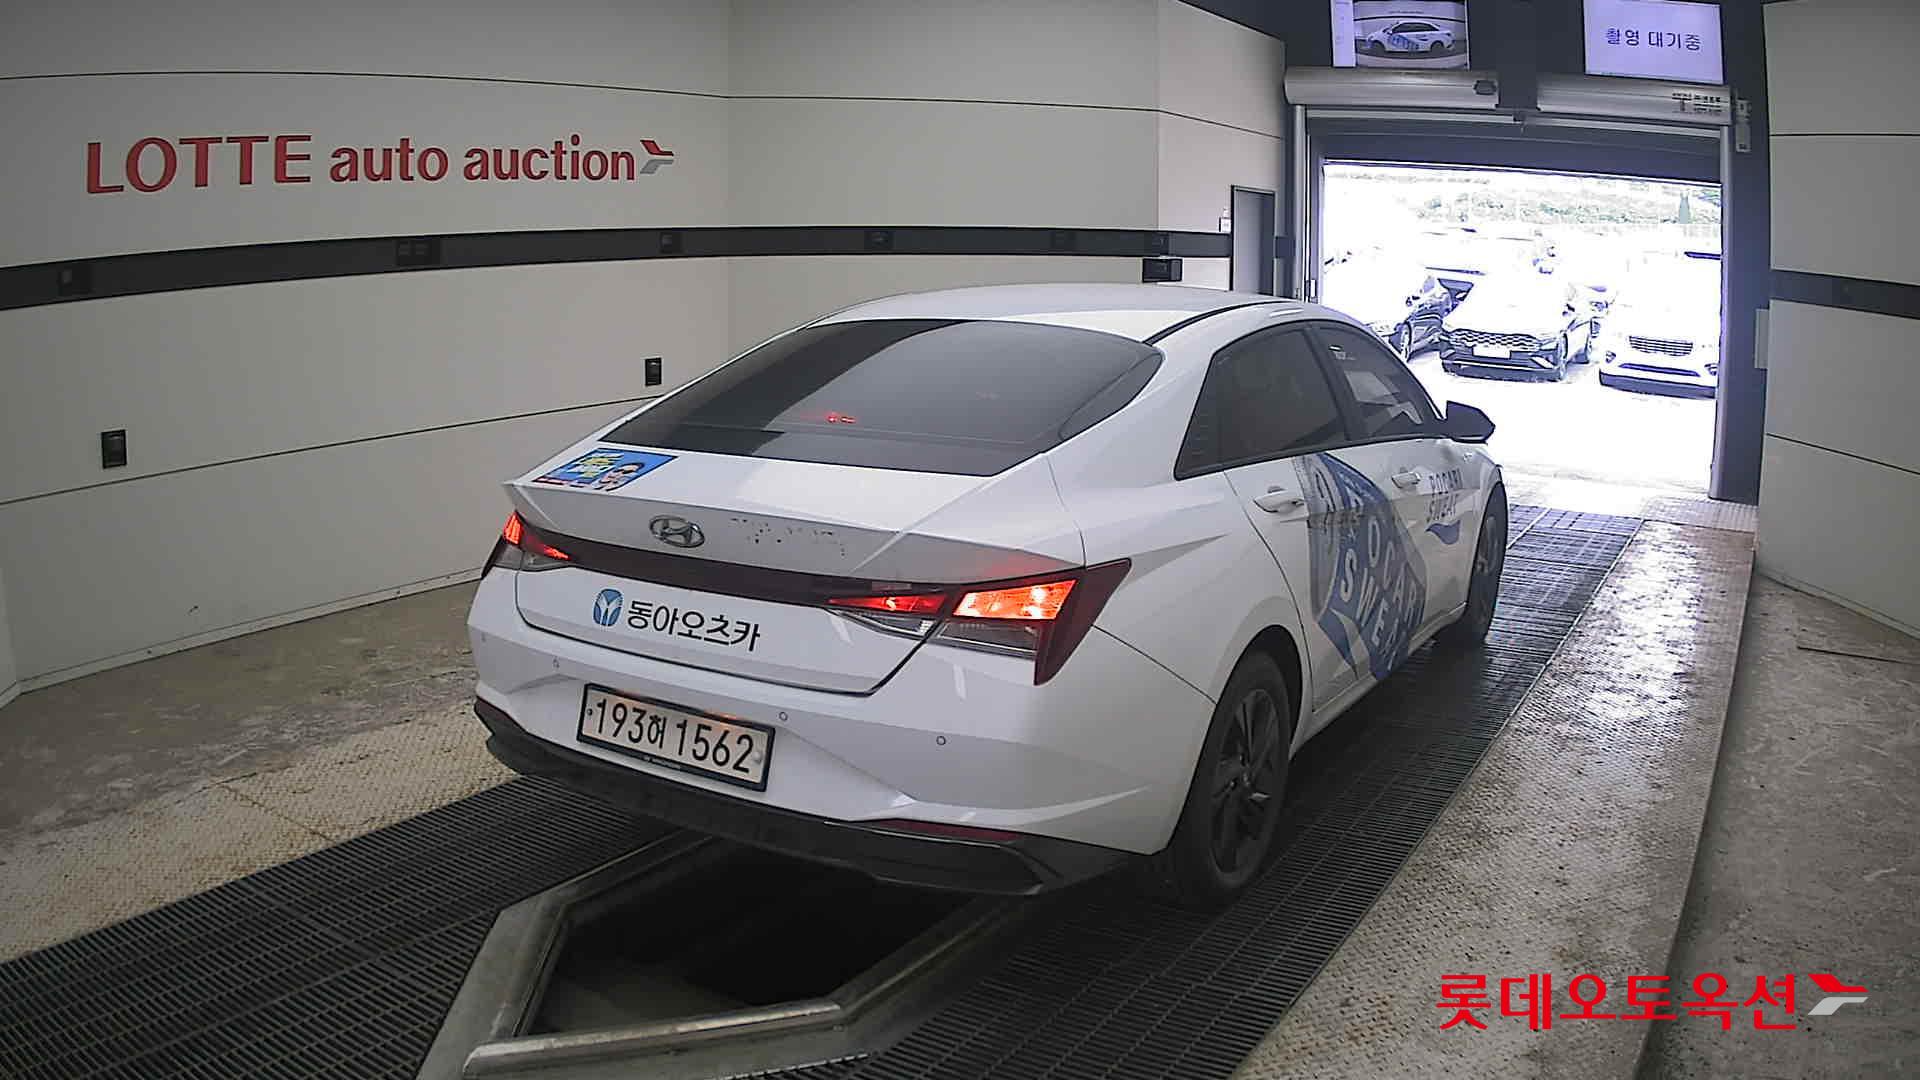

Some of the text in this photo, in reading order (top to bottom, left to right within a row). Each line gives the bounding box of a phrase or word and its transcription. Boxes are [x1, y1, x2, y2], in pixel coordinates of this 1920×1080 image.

[1606, 27, 1701, 51] 촬영 대기중
[86, 133, 635, 195] LOTTE auto auction
[627, 599, 761, 652] 동아오츠카
[596, 698, 754, 774] 193허 1562
